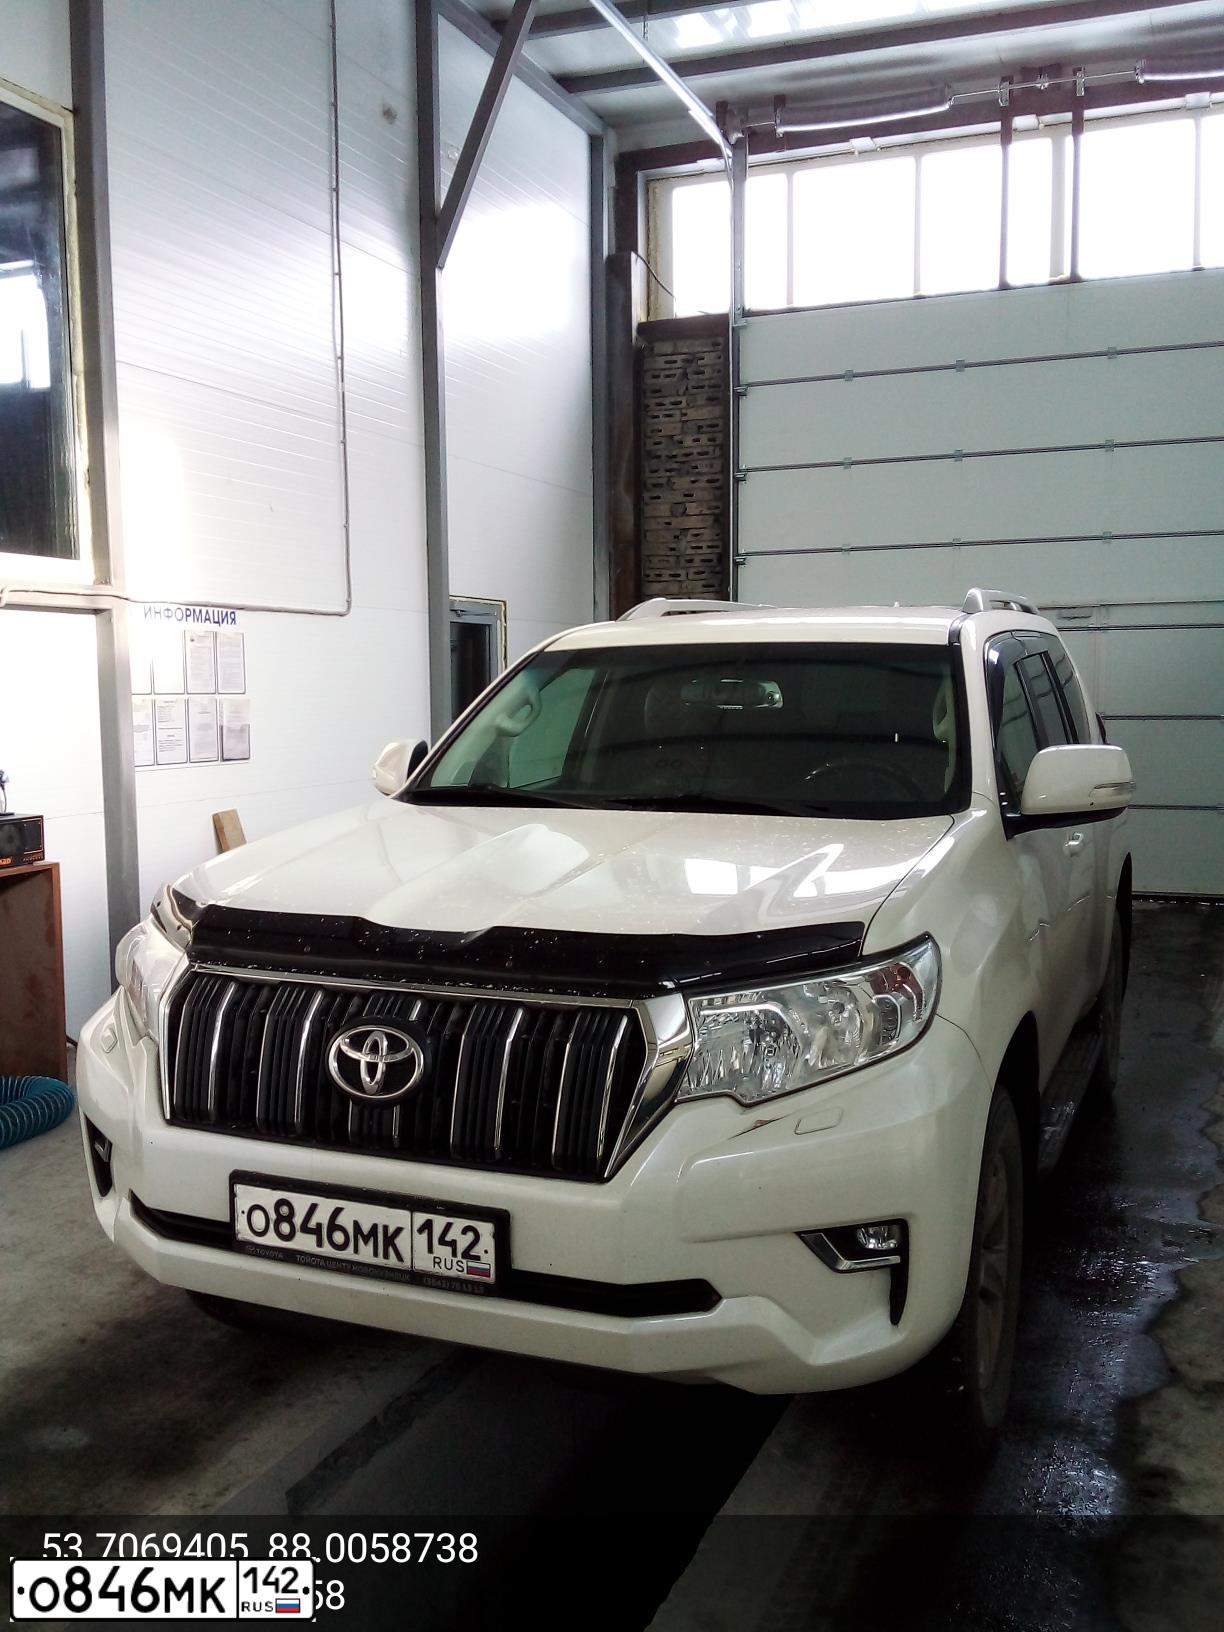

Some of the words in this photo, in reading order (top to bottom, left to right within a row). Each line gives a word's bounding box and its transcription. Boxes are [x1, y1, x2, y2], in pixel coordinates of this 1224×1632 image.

[144, 605, 237, 626] ИНФОРМАЦИЯ
[416, 1218, 482, 1262] 142
[432, 1256, 465, 1274] RUS
